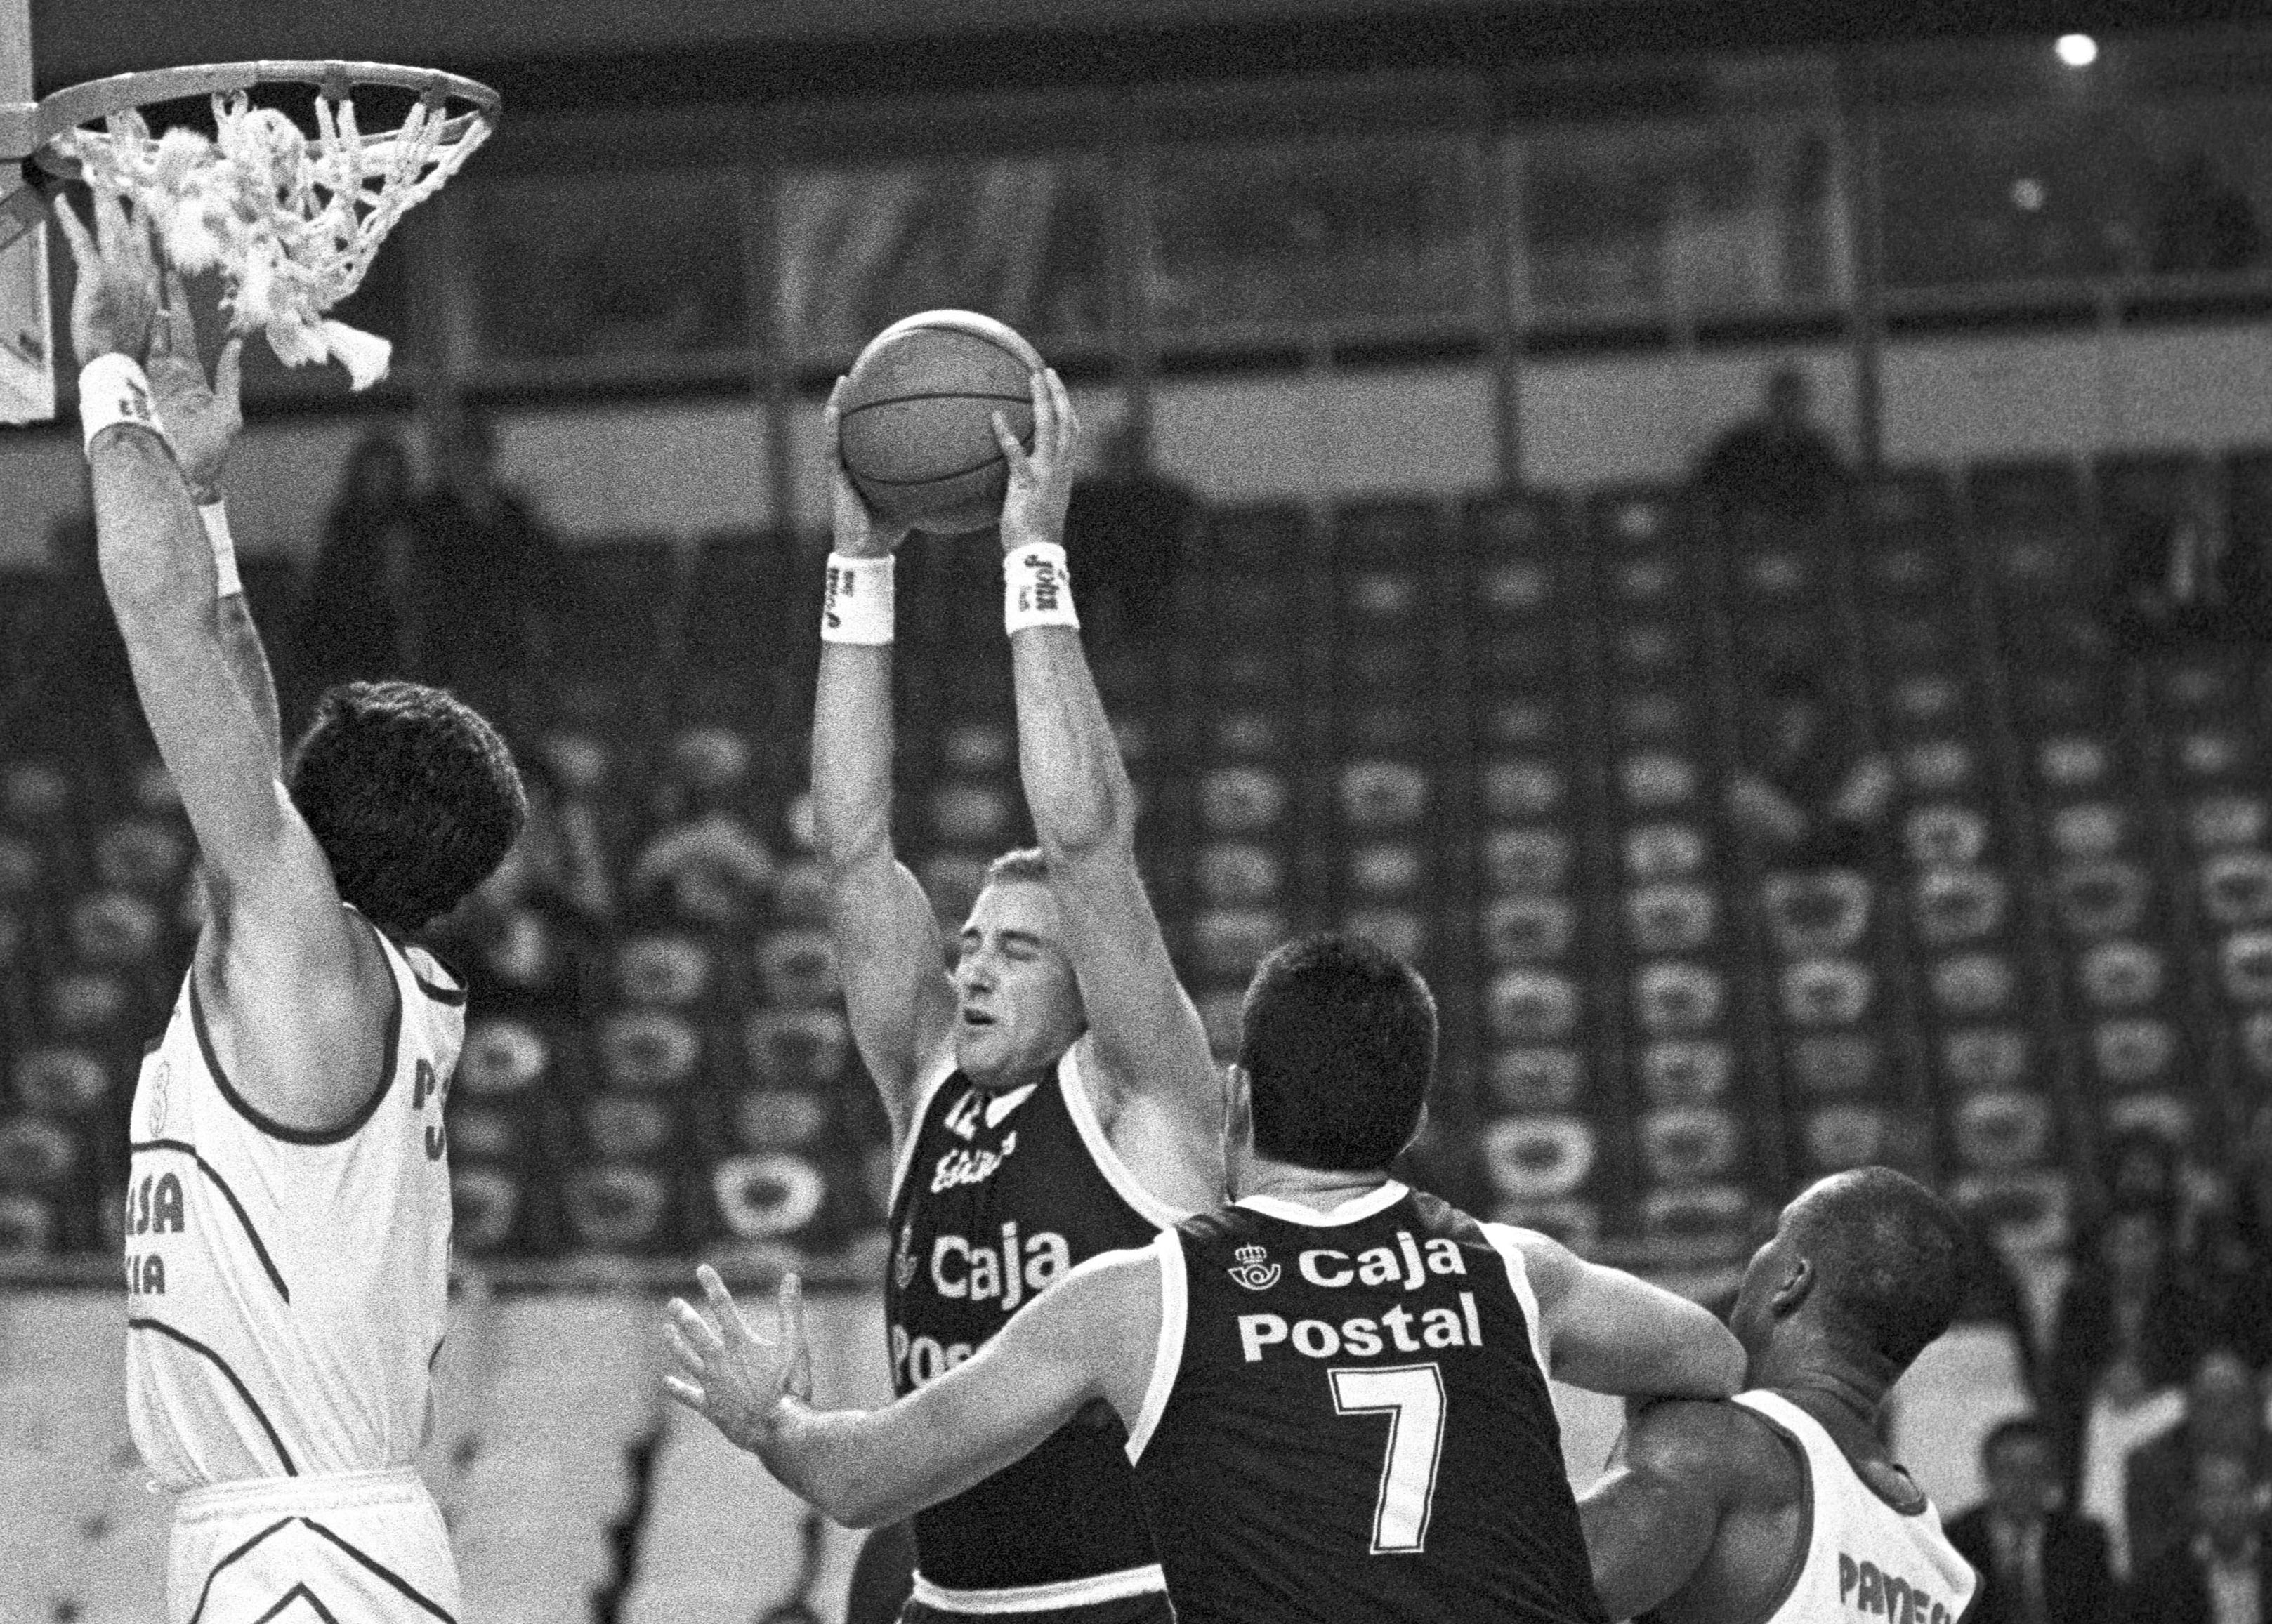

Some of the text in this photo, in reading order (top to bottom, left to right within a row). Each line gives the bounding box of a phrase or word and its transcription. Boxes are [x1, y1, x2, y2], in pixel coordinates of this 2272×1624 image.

[931, 1220, 1071, 1311] Caja
[1299, 1231, 1467, 1290] Caja
[1237, 1291, 1483, 1363] Postal
[1327, 1361, 1447, 1555] 7
